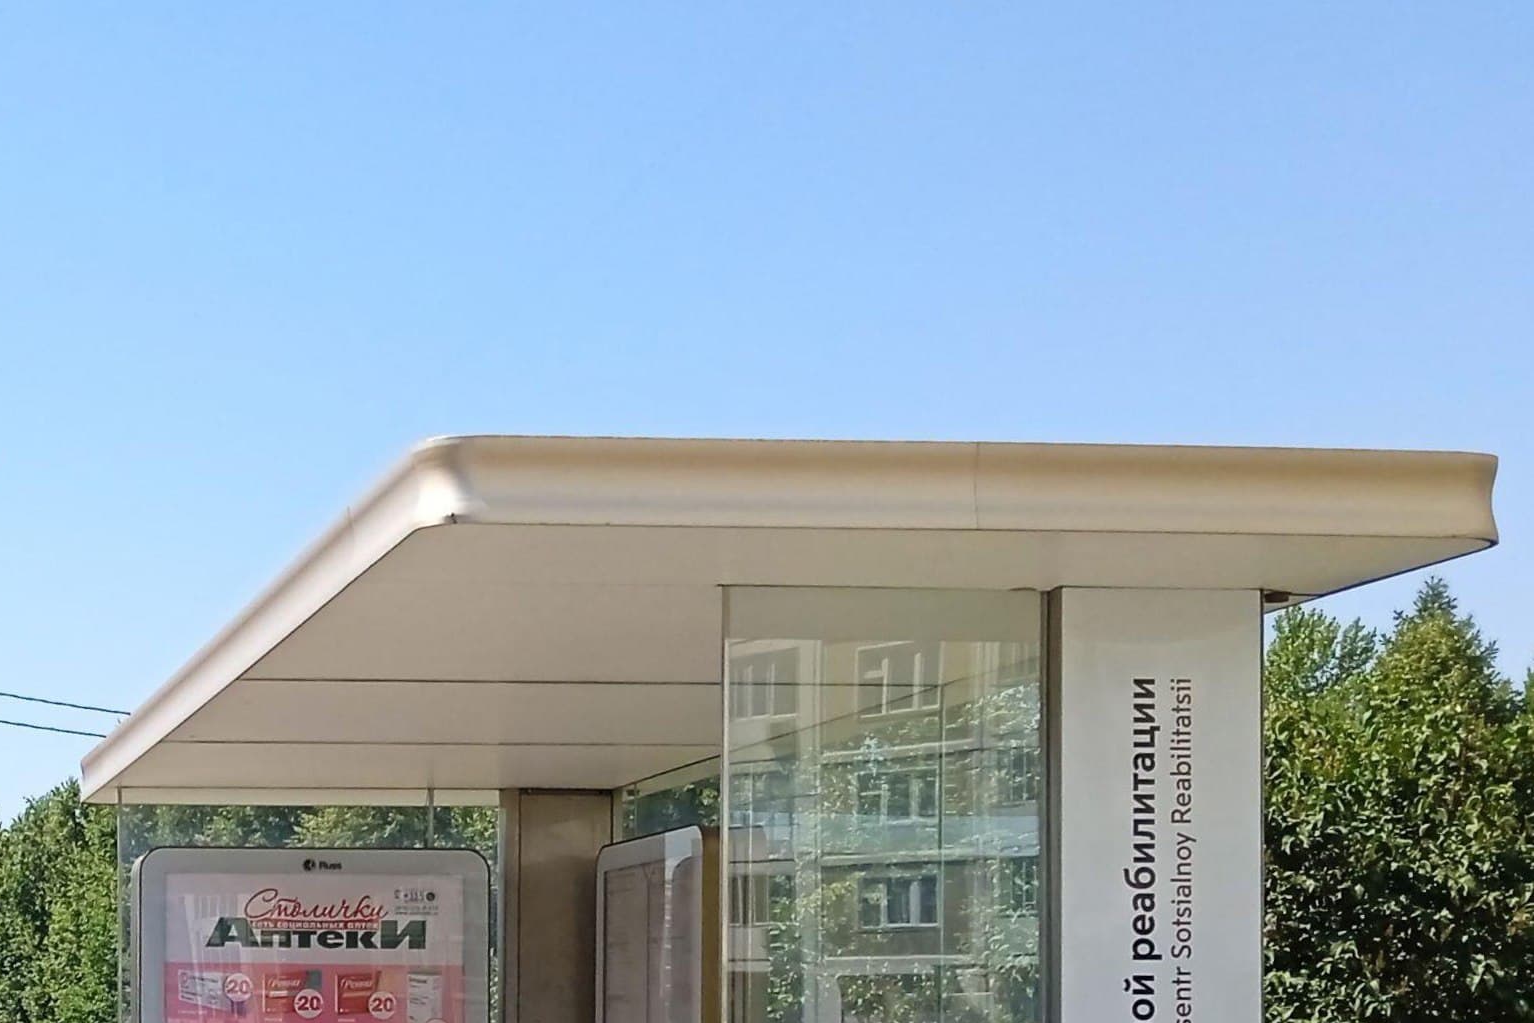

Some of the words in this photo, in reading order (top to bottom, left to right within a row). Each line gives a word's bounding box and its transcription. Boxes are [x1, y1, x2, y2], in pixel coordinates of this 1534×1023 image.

[1170, 677, 1192, 824] Reabilitatsii
[1123, 677, 1162, 961] реабилитации
[244, 888, 388, 919] Столички
[277, 921, 345, 930] социальных
[1170, 832, 1197, 960] Sotsialnoy
